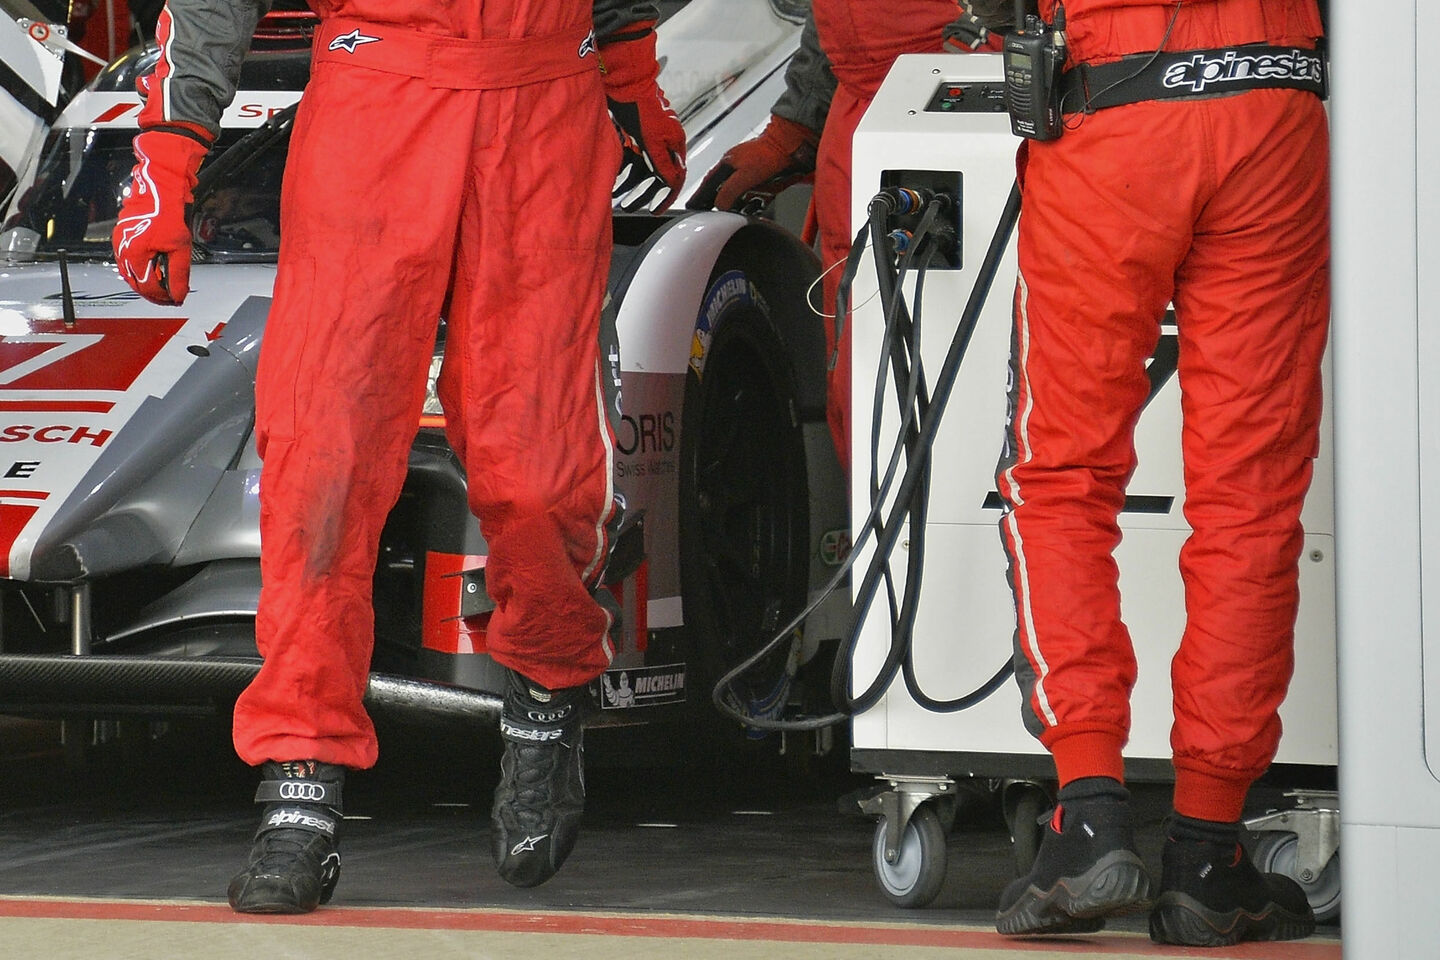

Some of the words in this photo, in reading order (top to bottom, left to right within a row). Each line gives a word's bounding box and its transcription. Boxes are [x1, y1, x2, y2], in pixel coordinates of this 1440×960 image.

[1163, 50, 1323, 91] alpinestars
[616, 412, 675, 456] ORIS
[635, 673, 684, 693] MICHELIN
